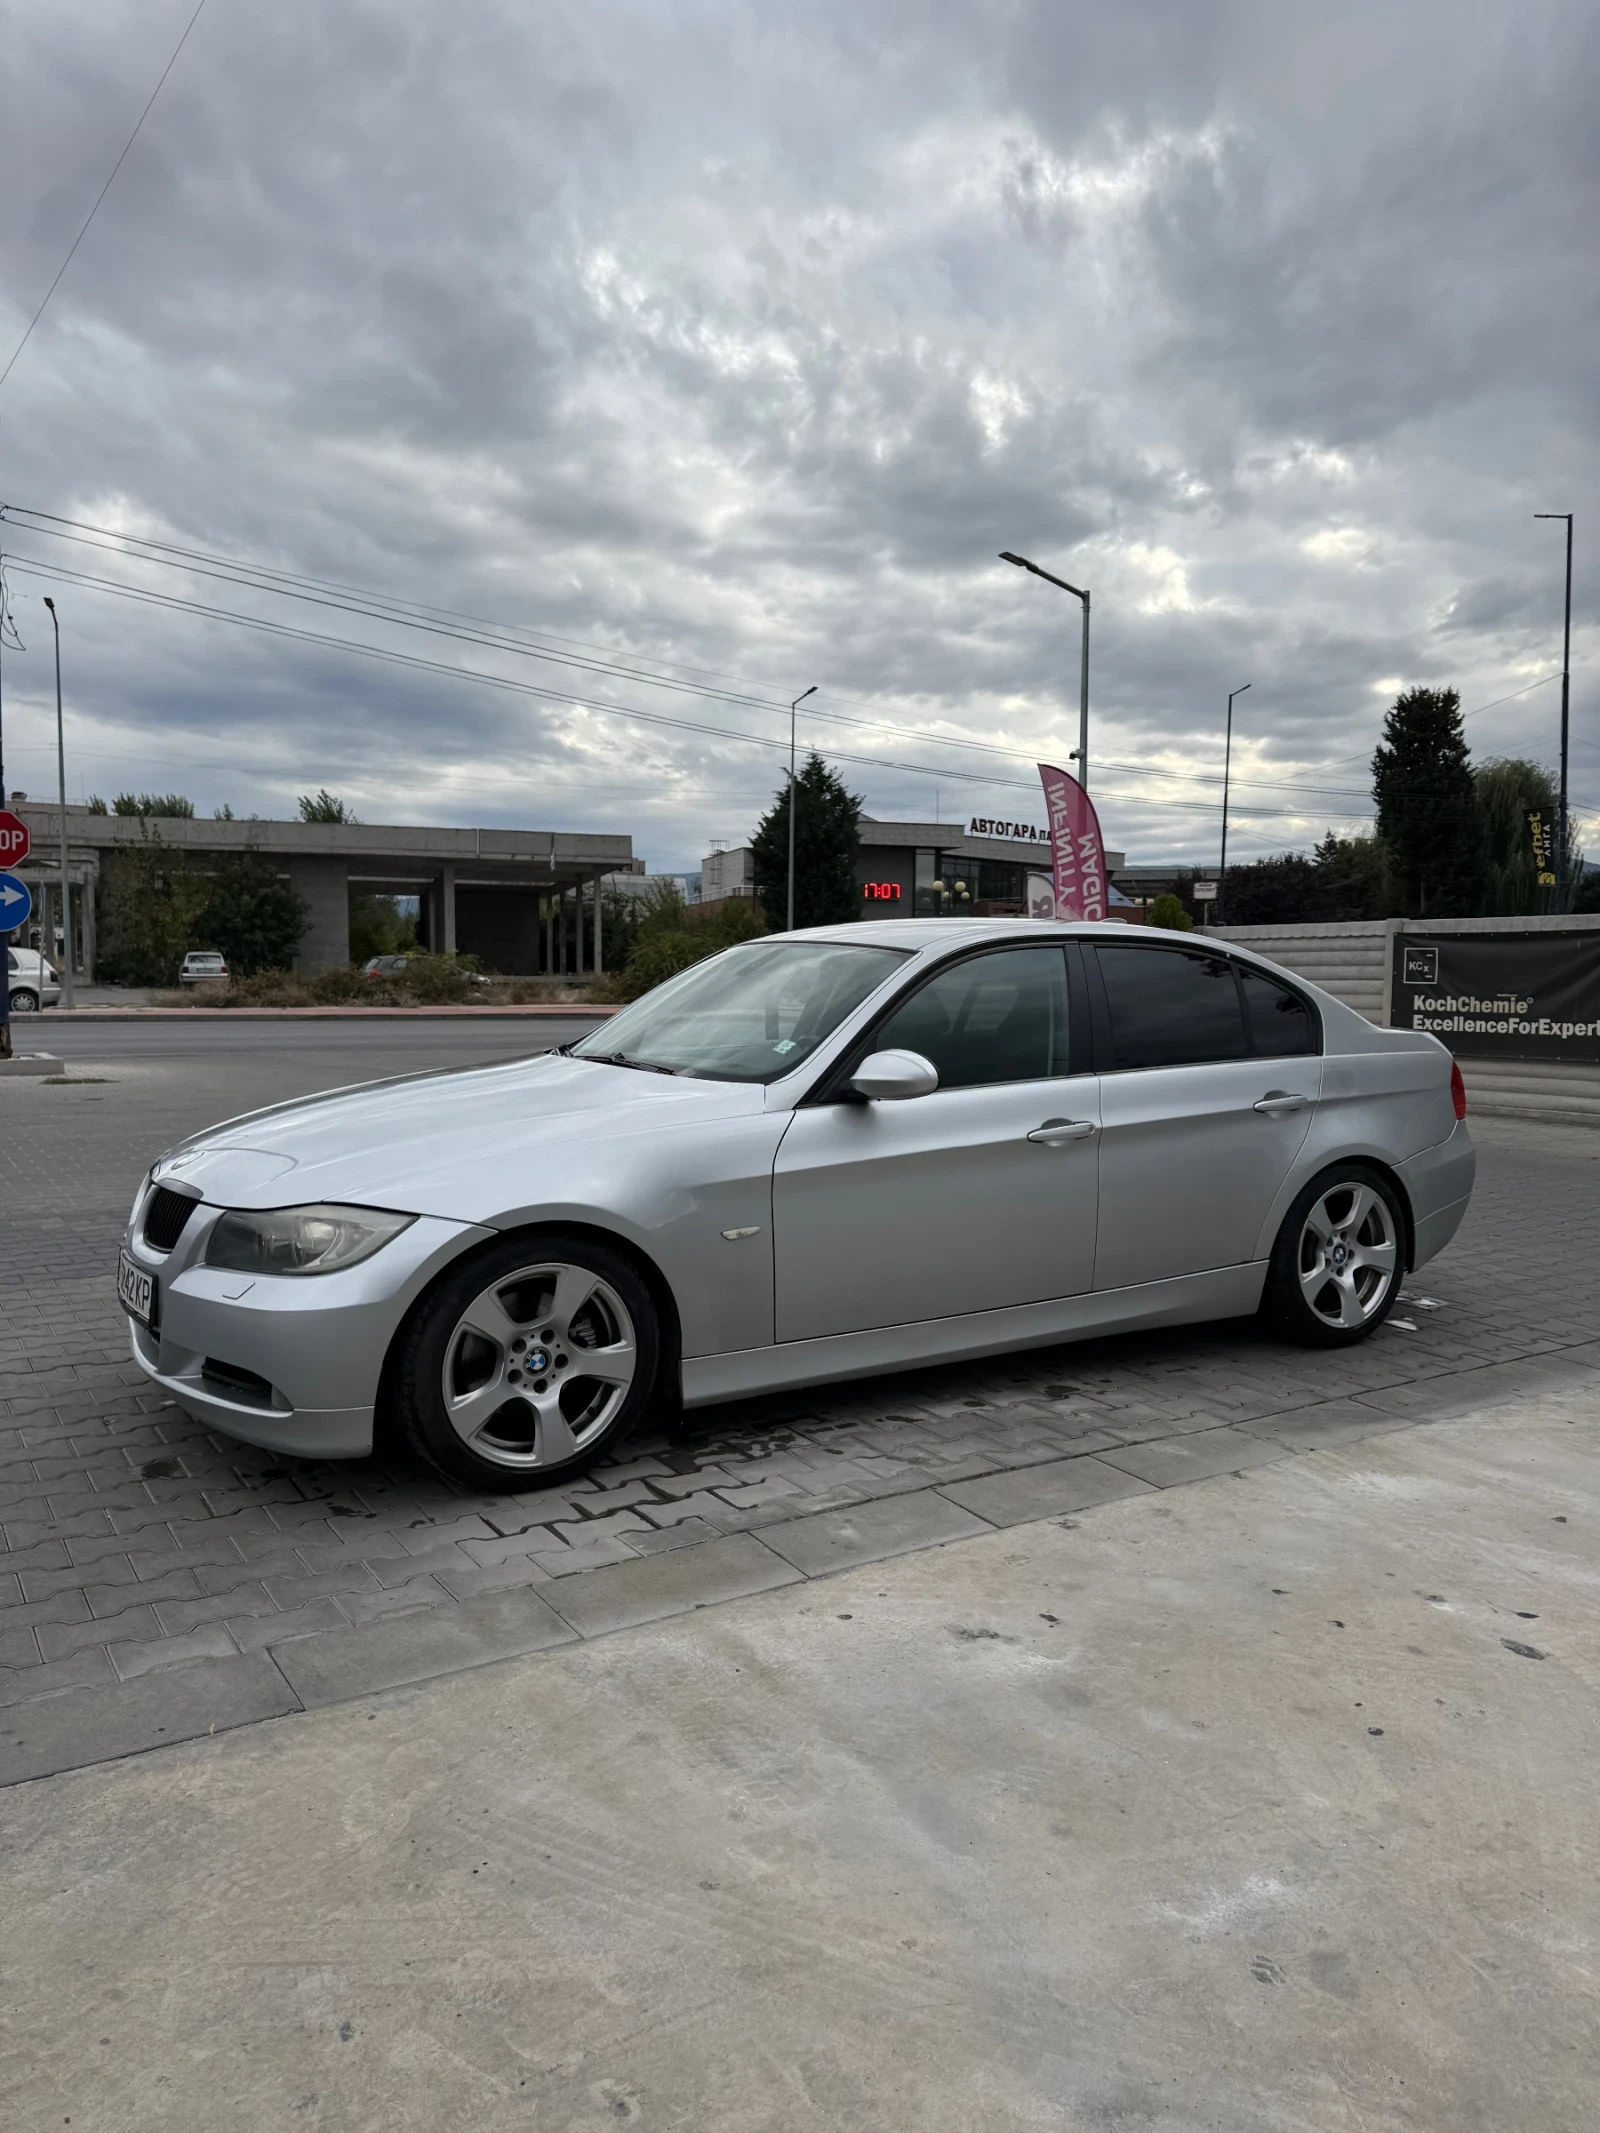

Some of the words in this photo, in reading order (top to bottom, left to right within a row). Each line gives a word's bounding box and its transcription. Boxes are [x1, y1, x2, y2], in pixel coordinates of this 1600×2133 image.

[970, 817, 1037, 840] АВТОГАРА
[1527, 812, 1546, 869] efbet
[864, 883, 900, 899] 17:07
